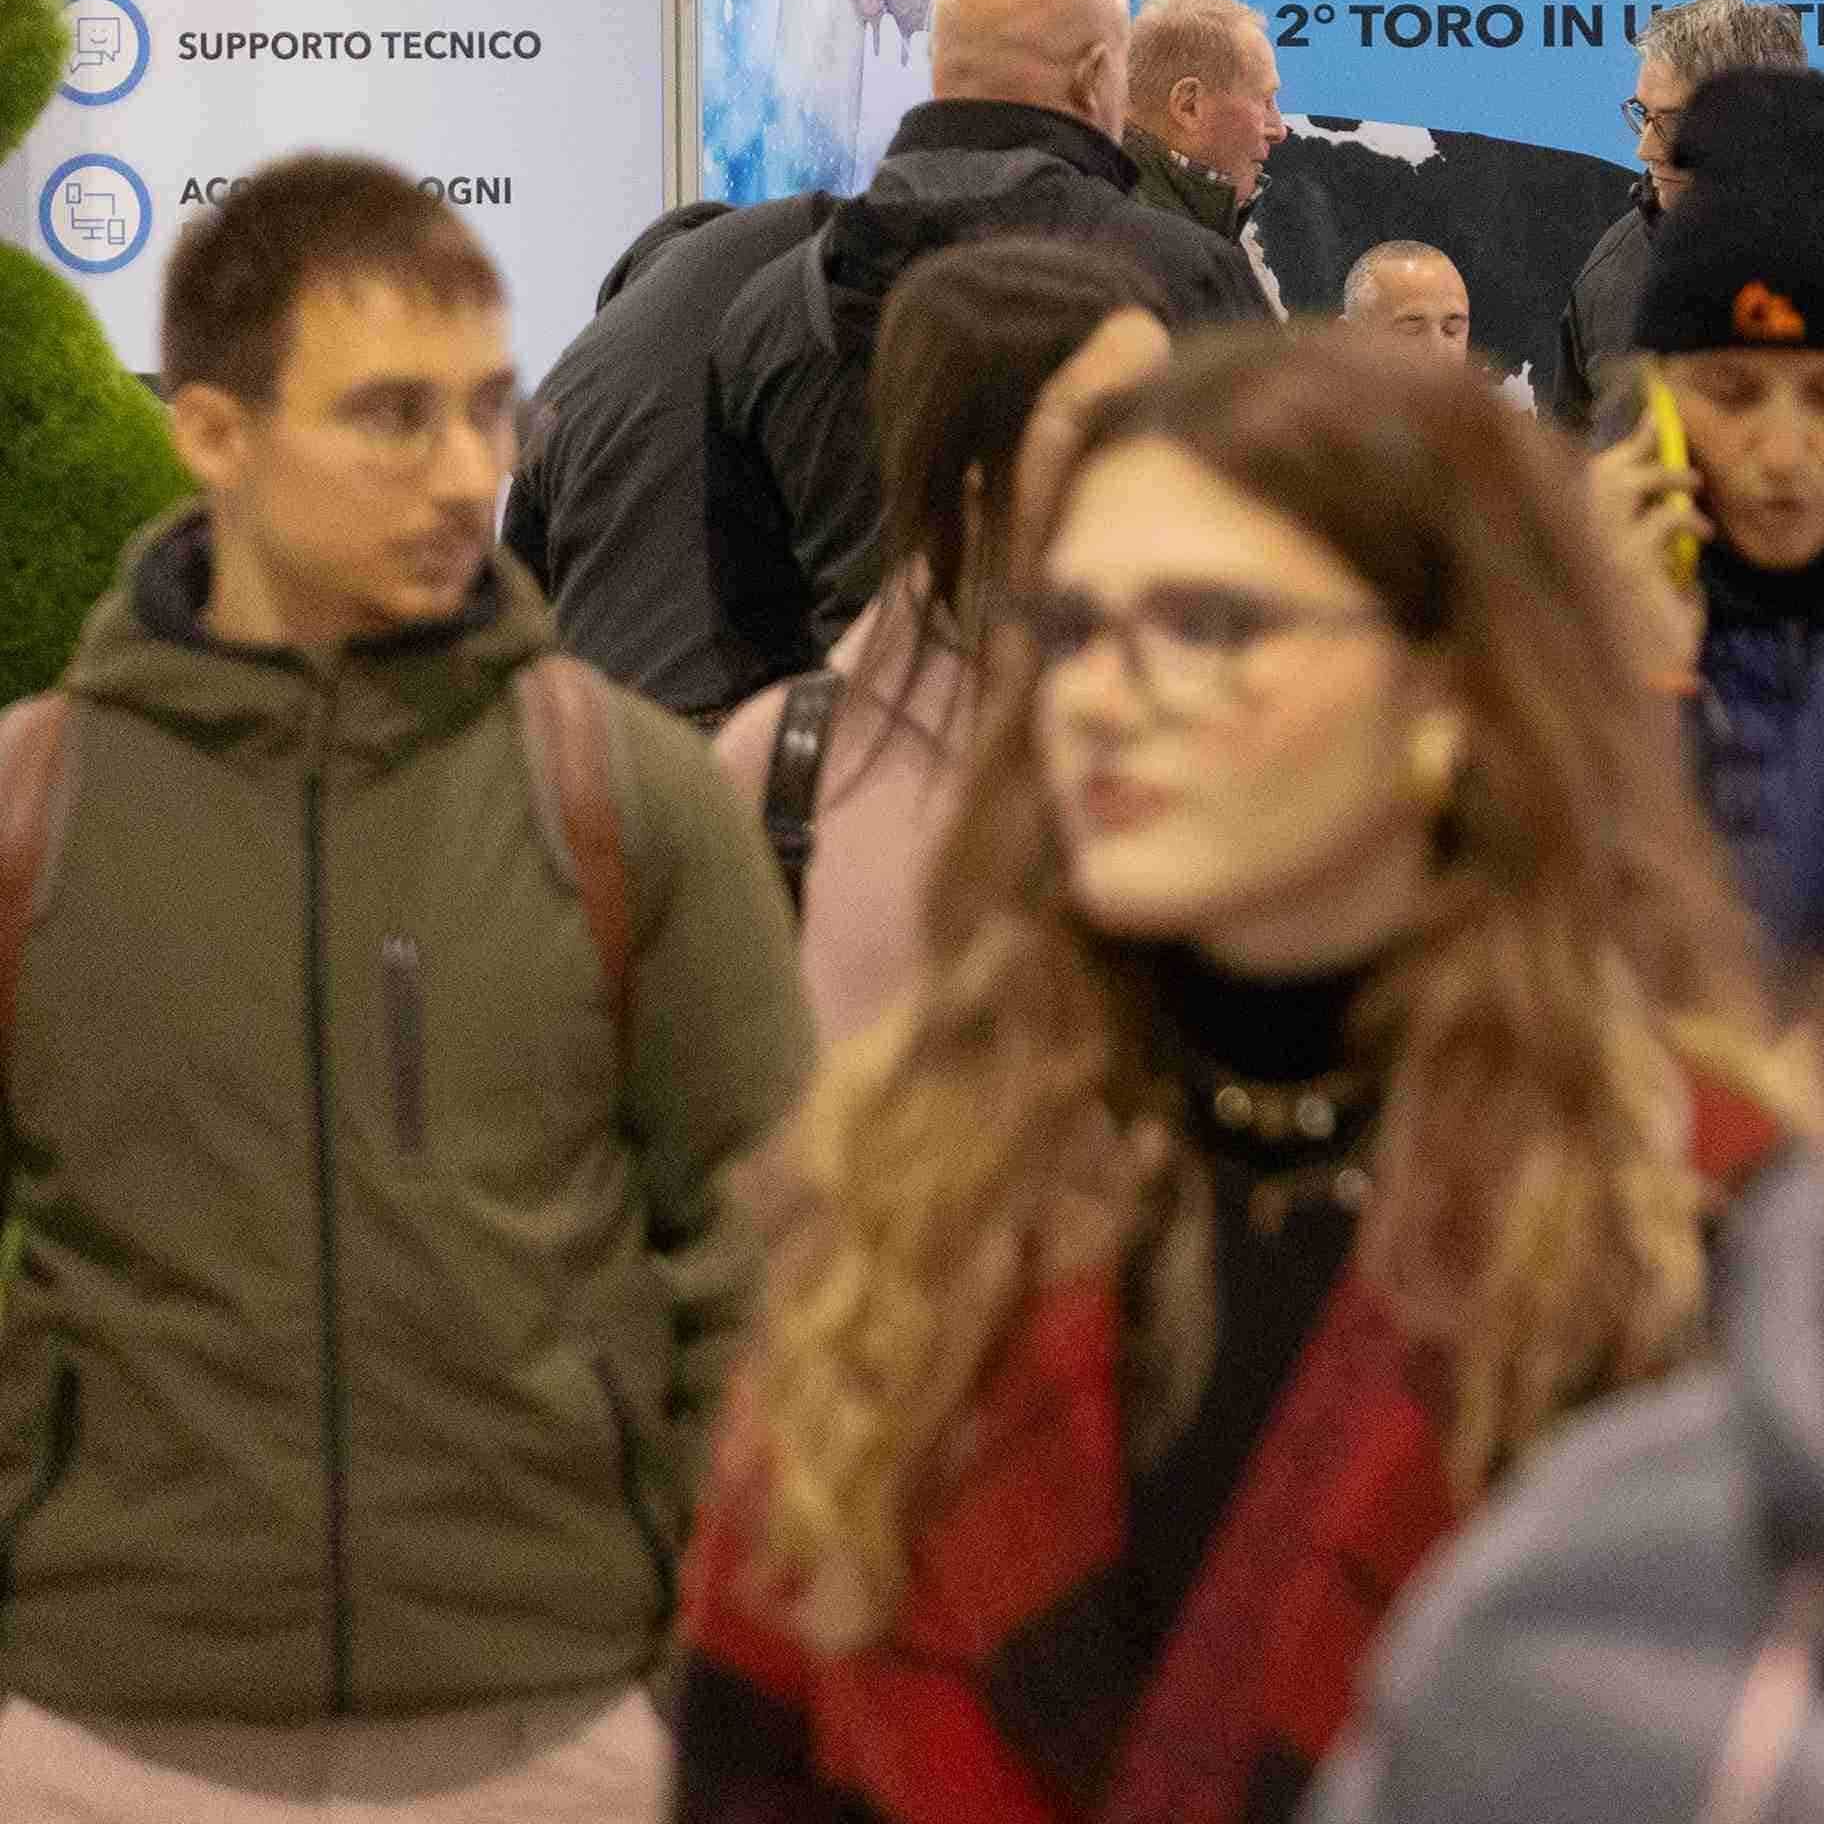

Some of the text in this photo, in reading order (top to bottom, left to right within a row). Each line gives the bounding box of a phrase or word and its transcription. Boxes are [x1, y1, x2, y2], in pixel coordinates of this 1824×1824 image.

[1276, 4, 1334, 47] 2°
[1349, 4, 1524, 48] TORO
[1544, 5, 1602, 47] IN
[179, 31, 541, 60] SUPPORTO TECNICO
[417, 176, 512, 206] OGNI
